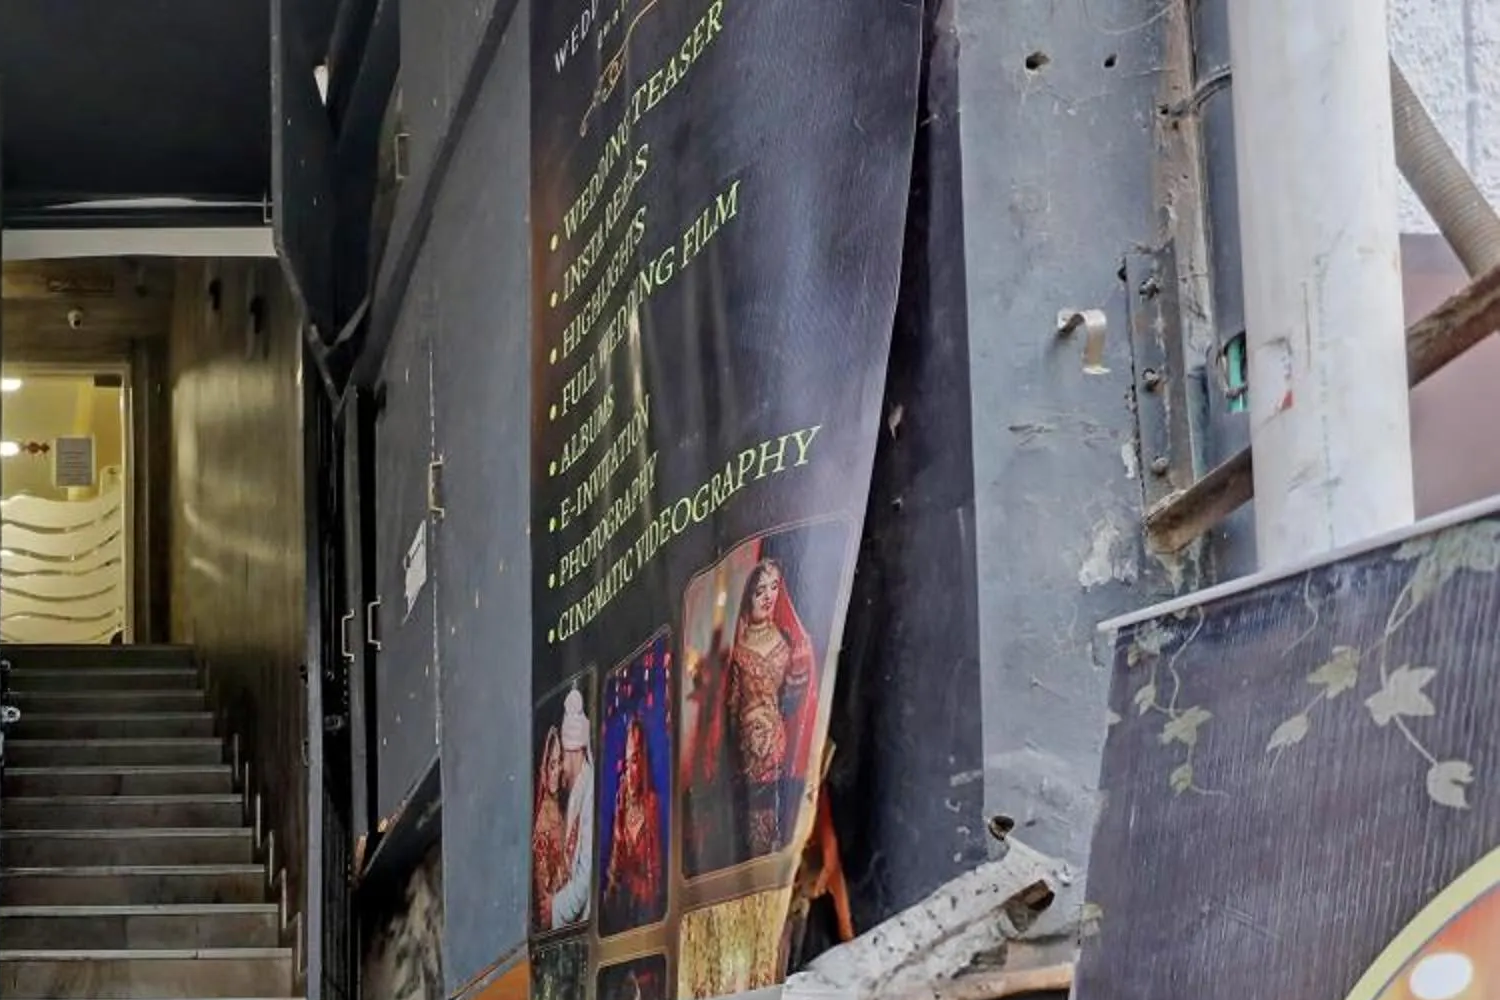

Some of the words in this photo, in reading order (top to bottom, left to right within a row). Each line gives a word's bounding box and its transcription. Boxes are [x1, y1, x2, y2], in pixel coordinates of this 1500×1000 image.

[632, 0, 723, 125] TEASER
[563, 223, 604, 302] INSTA
[605, 143, 648, 239] REELS
[563, 205, 647, 358] HIGHLIGHTS
[562, 353, 597, 416] FULL
[680, 179, 740, 269] FILM
[560, 384, 614, 475] ALBUMS
[560, 393, 650, 530] E-INVITATION
[558, 548, 633, 642] CINEMATIC
[636, 424, 821, 569] VIDEOGRAPHY
[559, 450, 658, 587] PHOTOGRAPHY
